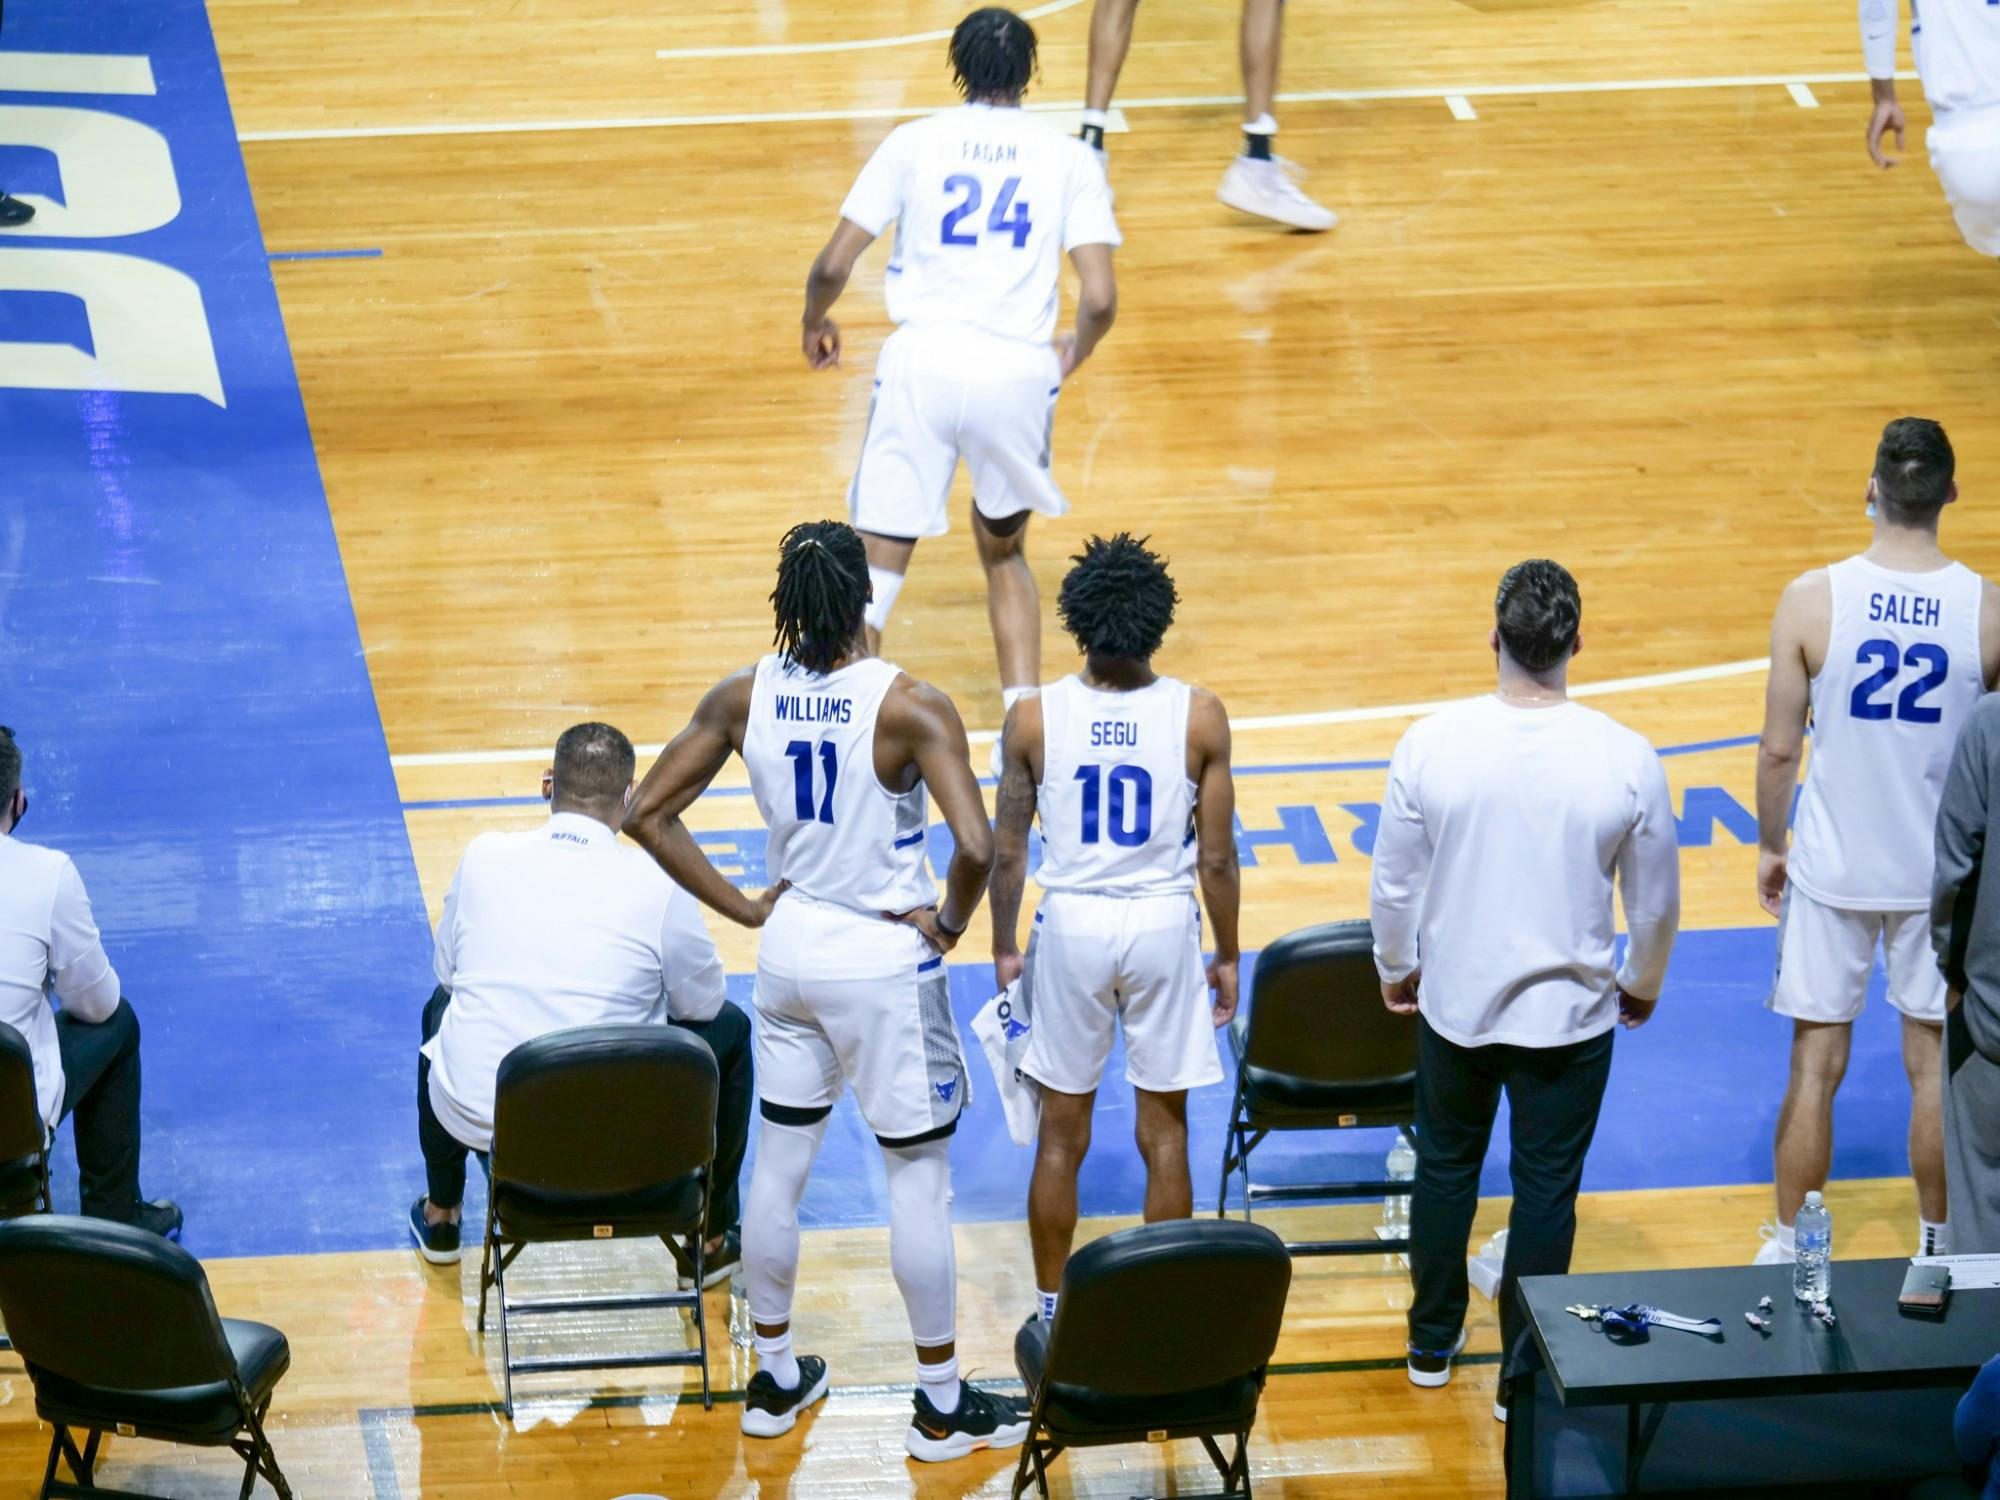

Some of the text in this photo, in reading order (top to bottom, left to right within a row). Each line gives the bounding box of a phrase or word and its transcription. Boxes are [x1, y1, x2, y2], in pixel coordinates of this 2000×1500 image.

[961, 141, 1018, 163] FAGAN
[940, 174, 1033, 248] 24
[1868, 592, 1941, 628] SALEH
[1849, 638, 1949, 724] 22
[775, 694, 853, 724] WILLIAMS
[1090, 721, 1138, 747] SEGU
[784, 740, 838, 825] 11
[1072, 764, 1153, 847] 10
